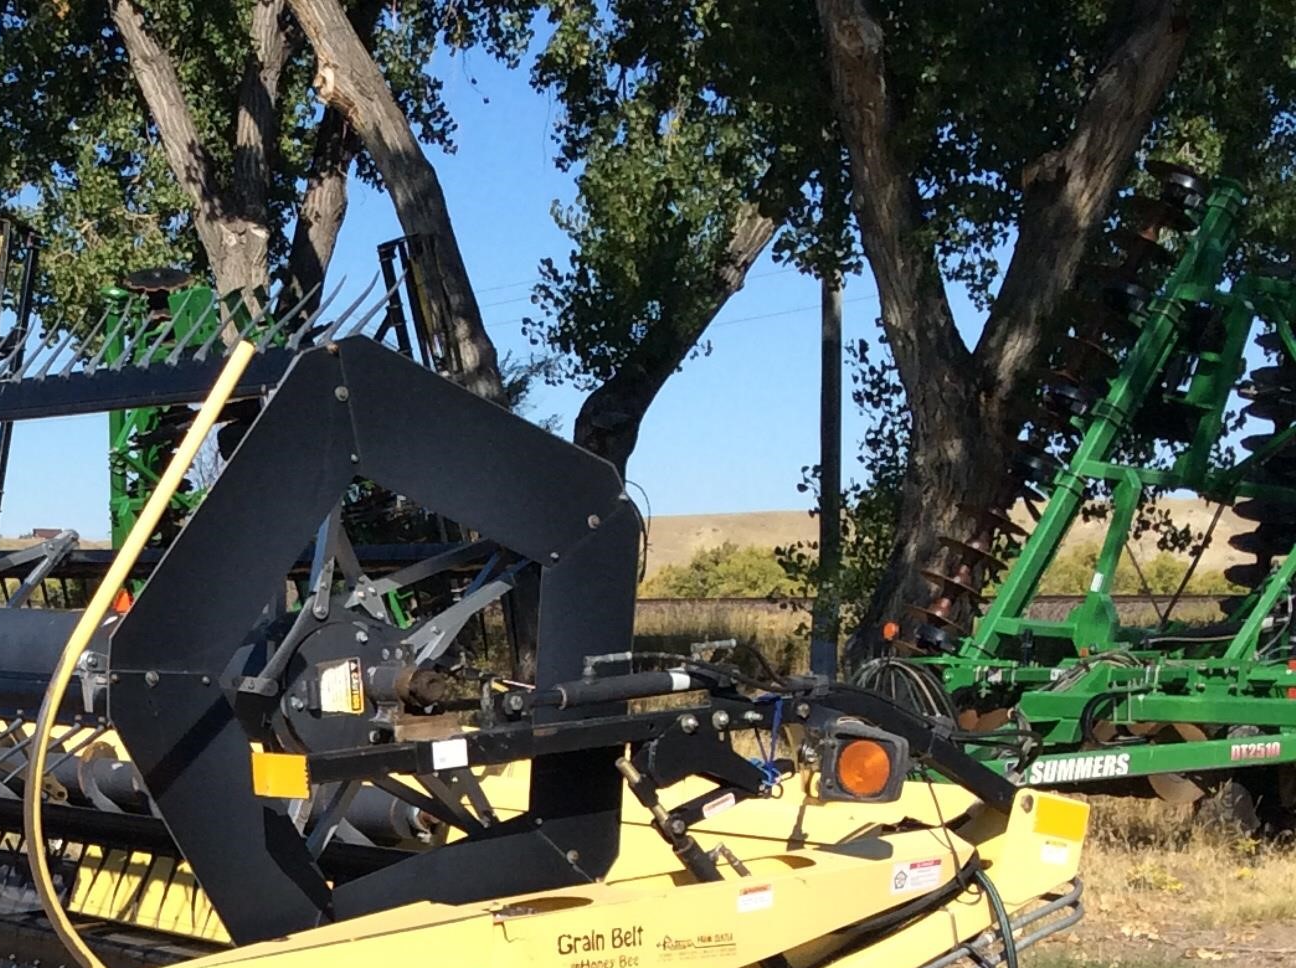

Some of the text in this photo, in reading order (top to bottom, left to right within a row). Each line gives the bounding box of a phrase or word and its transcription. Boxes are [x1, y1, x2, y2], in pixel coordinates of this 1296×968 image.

[1230, 741, 1281, 761] DT2510
[1029, 753, 1131, 784] SUMMERS
[557, 928, 605, 955] Grain
[611, 925, 644, 949] Belt
[619, 954, 640, 968] Bee
